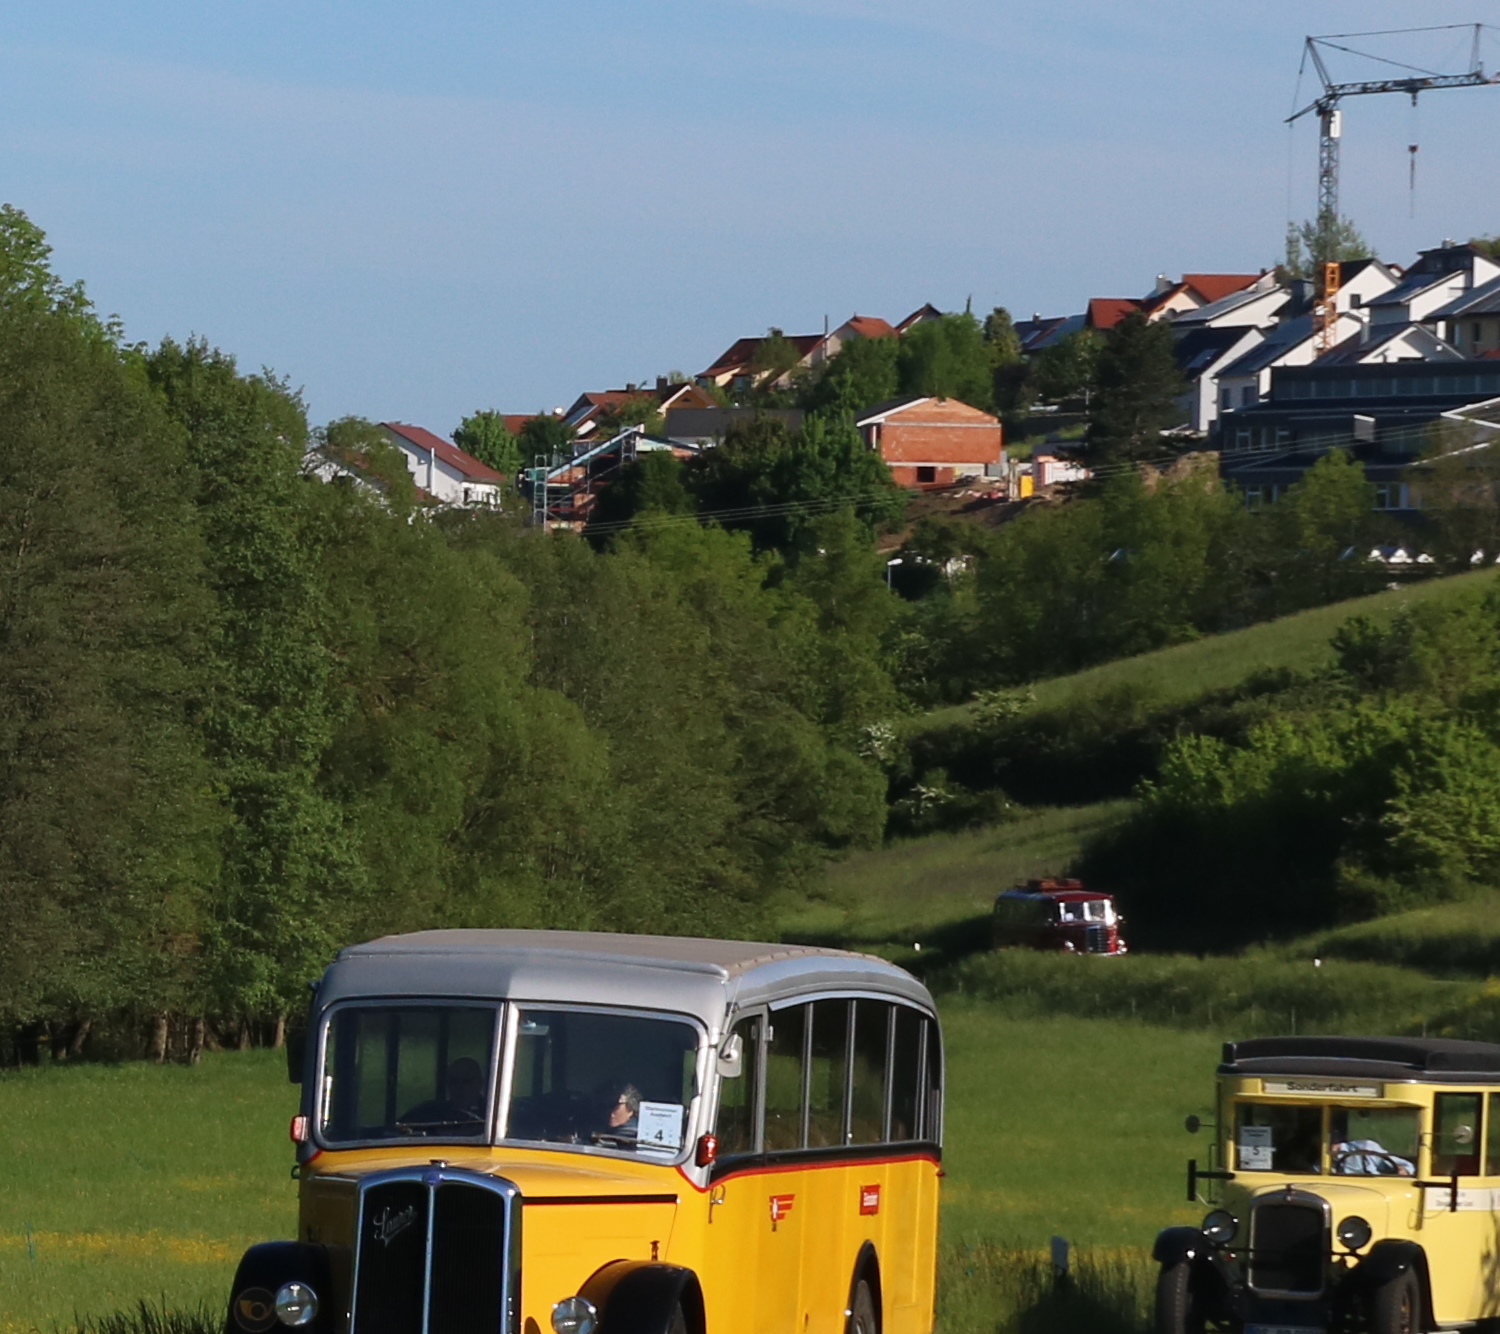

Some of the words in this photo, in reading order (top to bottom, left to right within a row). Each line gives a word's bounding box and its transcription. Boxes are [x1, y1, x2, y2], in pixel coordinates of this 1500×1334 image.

[1287, 1081, 1358, 1093] Sonderfahrt
[654, 1129, 665, 1142] 4
[1253, 1146, 1261, 1156] 5
